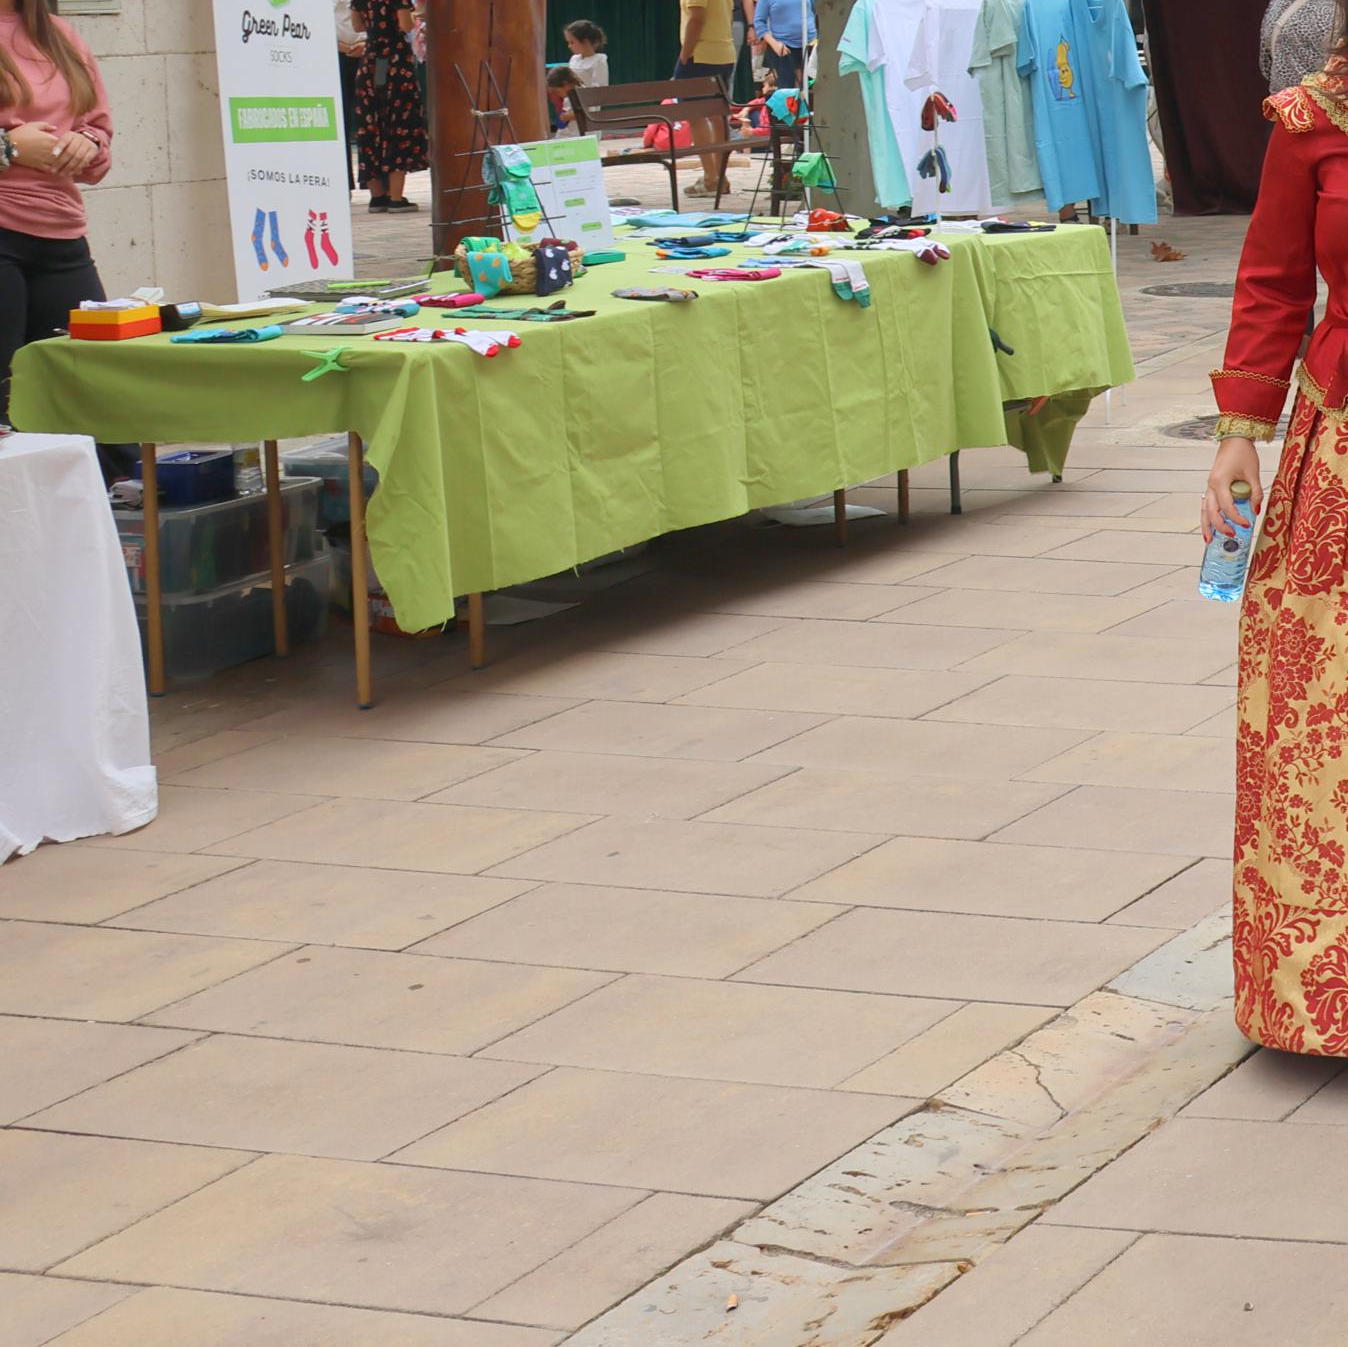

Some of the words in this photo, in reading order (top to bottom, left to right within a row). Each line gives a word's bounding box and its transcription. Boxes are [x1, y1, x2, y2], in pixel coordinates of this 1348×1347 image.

[241, 10, 279, 43] Green
[282, 13, 311, 40] Pear
[288, 173, 300, 184] LA
[303, 174, 330, 187] PERA!
